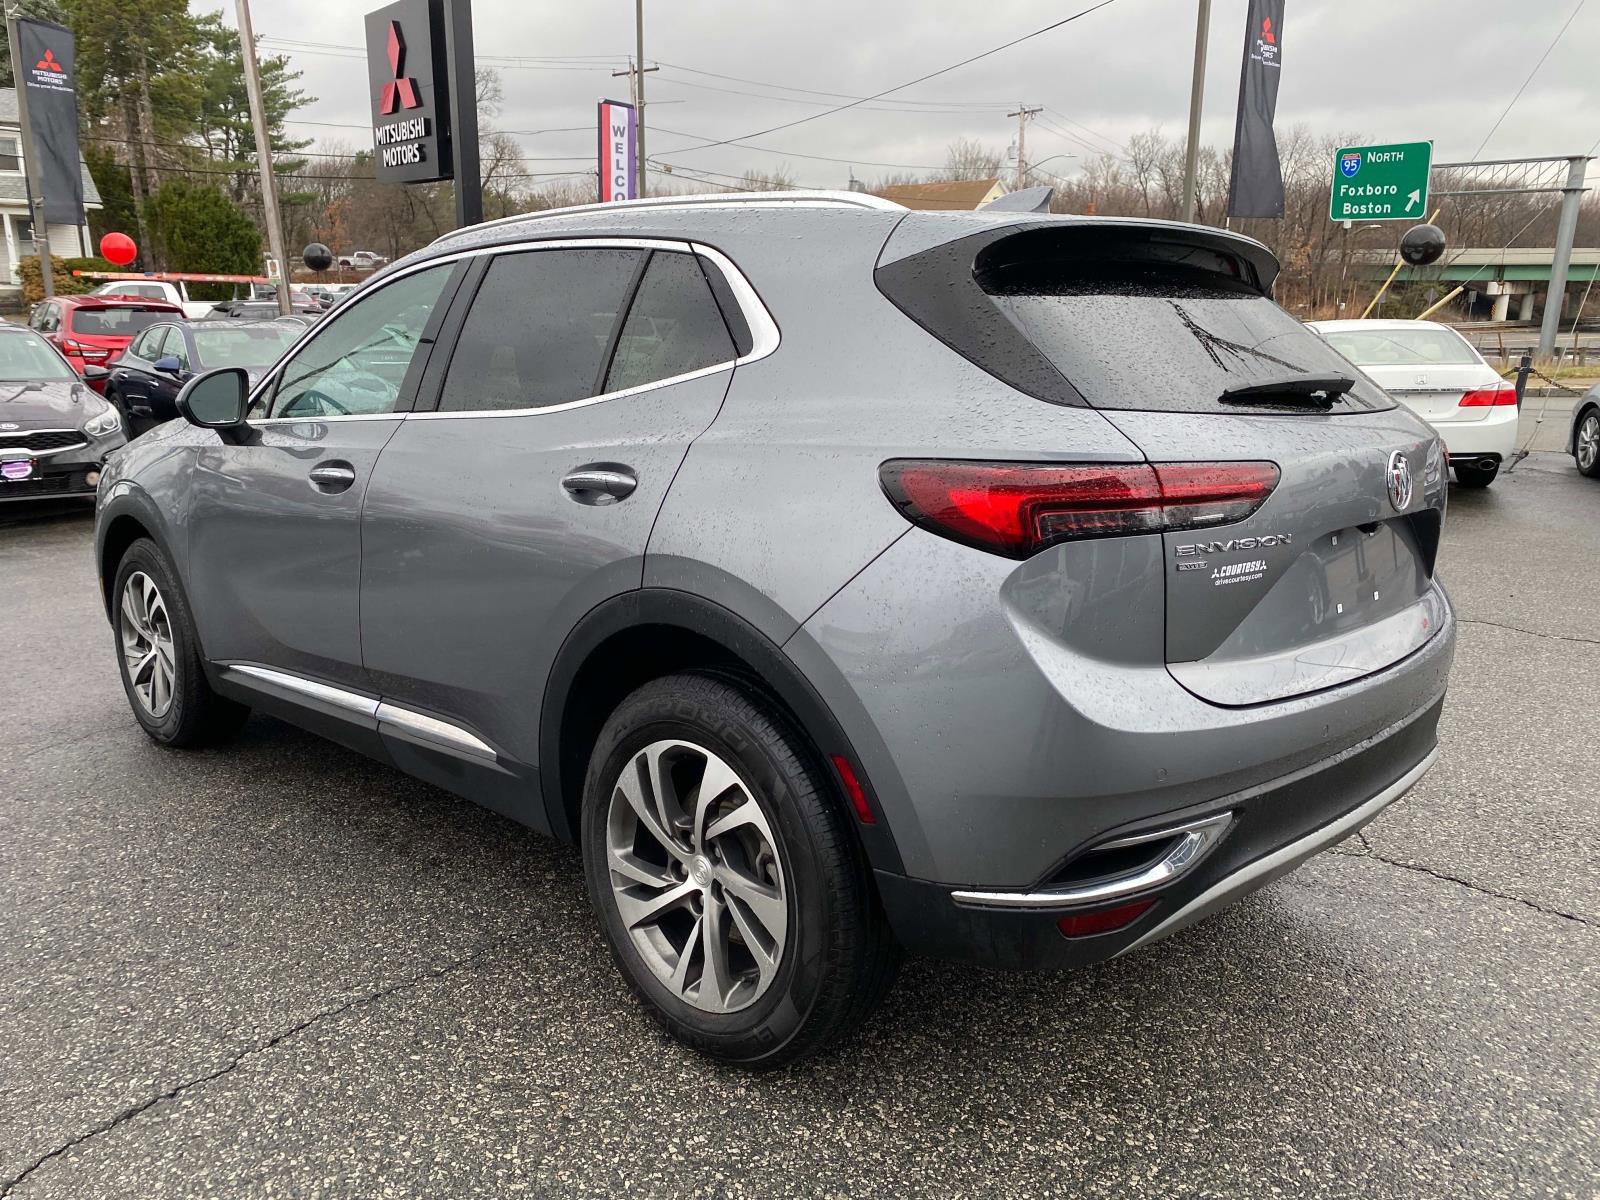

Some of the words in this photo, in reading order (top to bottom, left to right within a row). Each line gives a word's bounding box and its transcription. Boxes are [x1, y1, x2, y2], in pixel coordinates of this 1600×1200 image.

[32, 69, 67, 79] MITSUBISHI
[37, 76, 63, 85] MOTORS
[375, 117, 425, 146] MITSUBISHI
[382, 142, 420, 168] MOTORS
[1344, 160, 1358, 172] 95
[1367, 151, 1404, 163] NORTH
[1340, 184, 1398, 197] Foxboro
[1343, 202, 1391, 215] Boston
[1175, 533, 1292, 557] ENVISION
[1214, 573, 1263, 586] drivecourtesy.com
